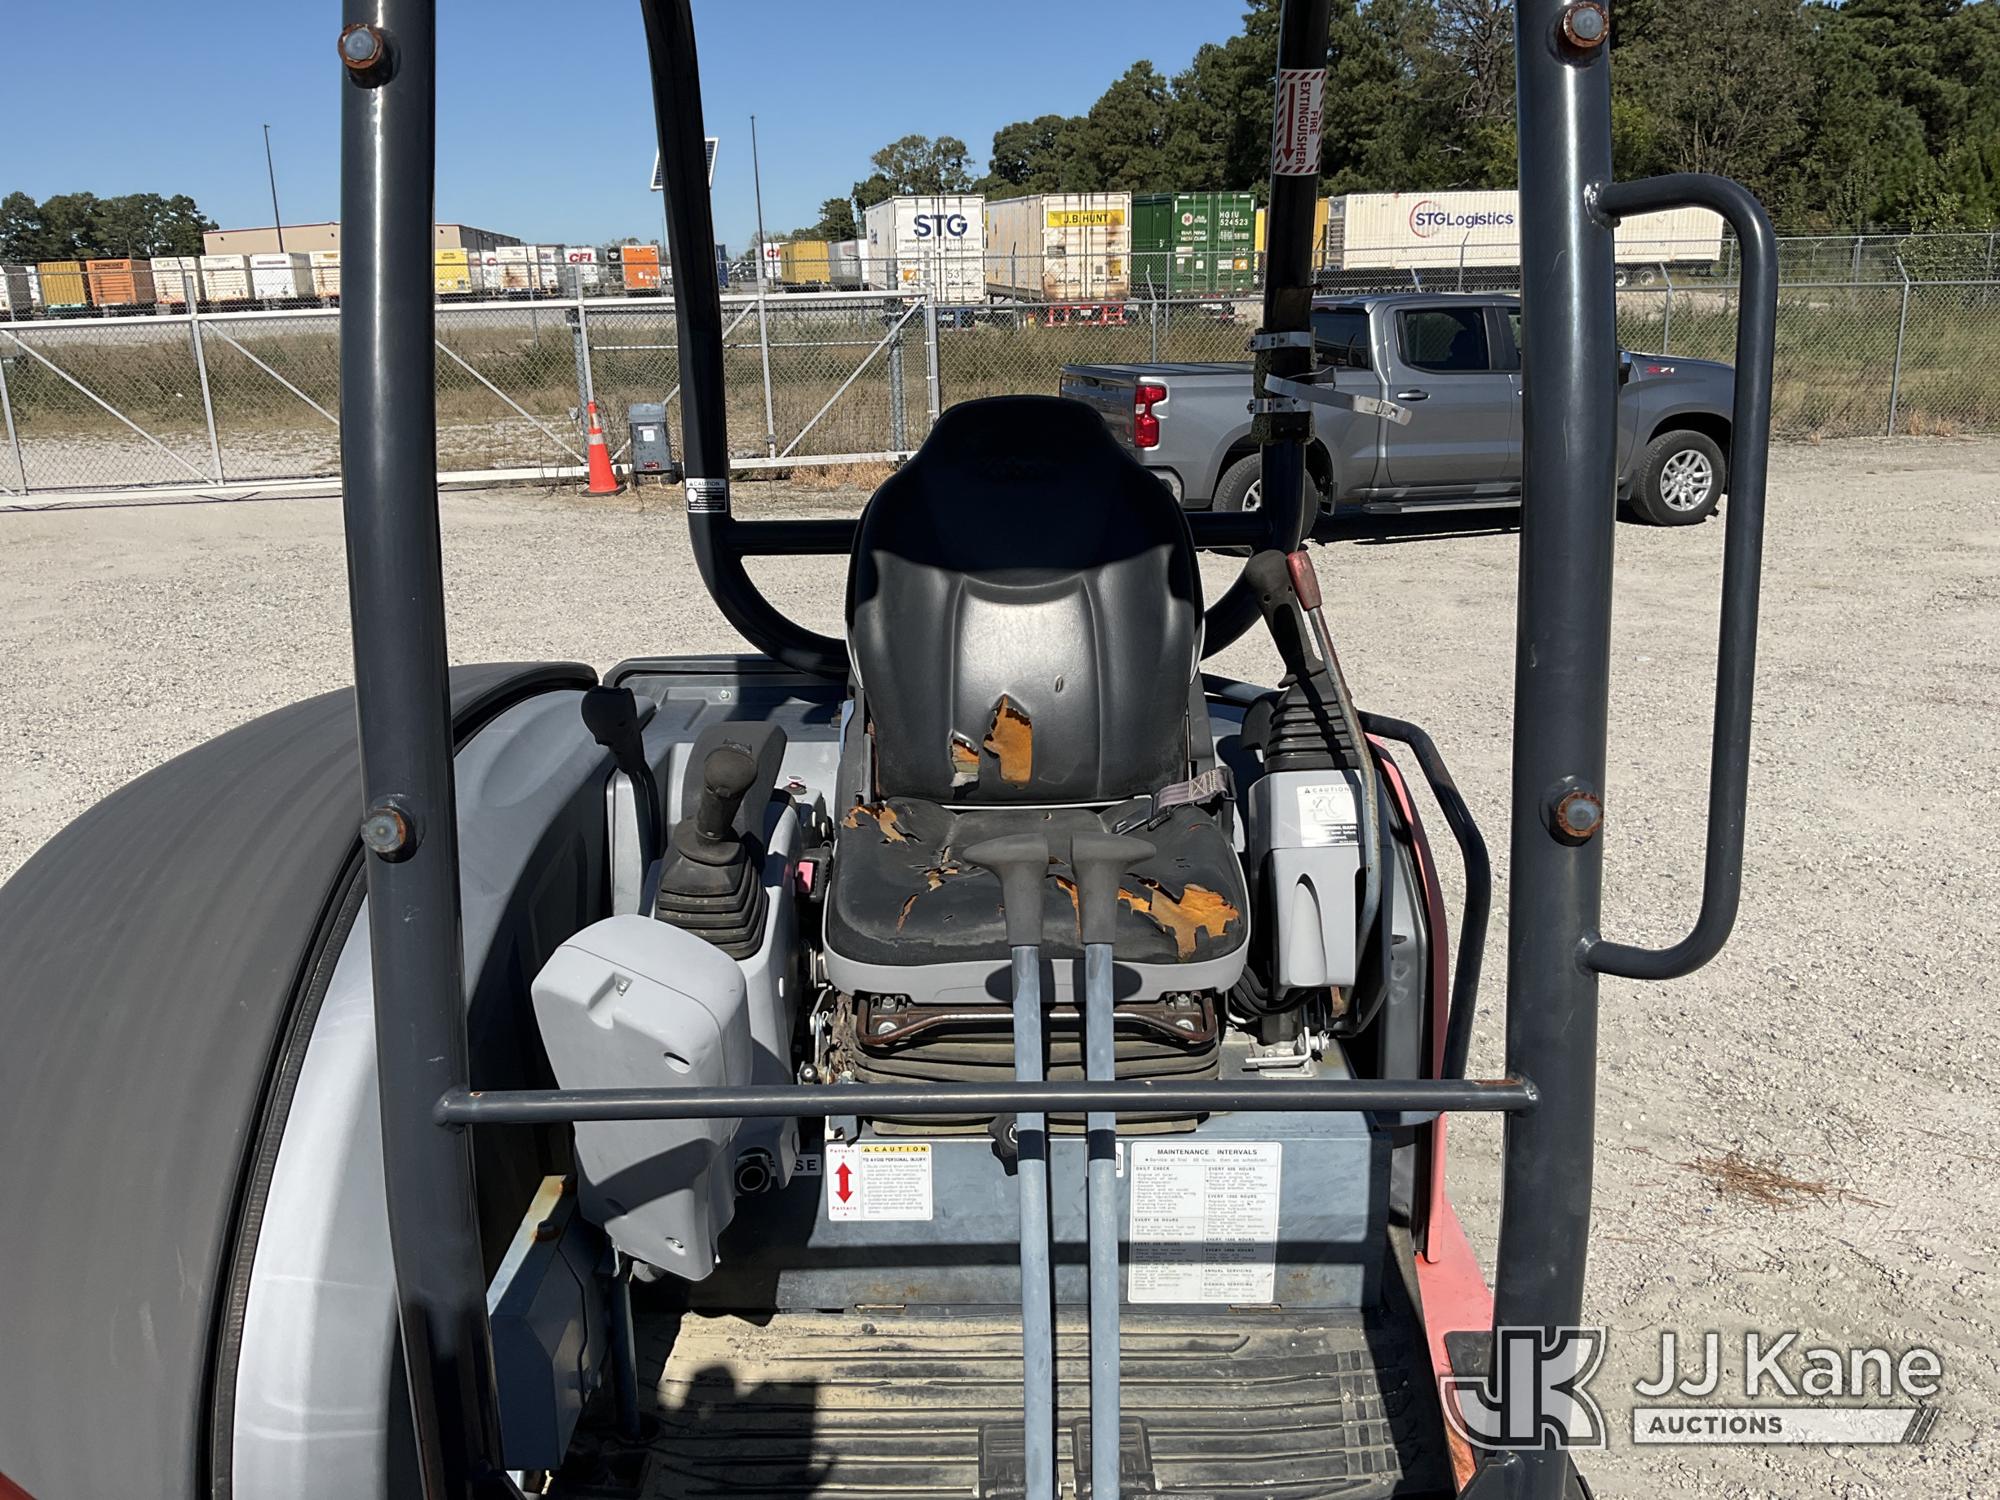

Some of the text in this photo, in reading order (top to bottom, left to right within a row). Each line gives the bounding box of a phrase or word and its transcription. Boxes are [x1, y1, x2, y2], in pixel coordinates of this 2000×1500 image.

[1295, 81, 1311, 165] EXTINGUISHER
[1309, 110, 1318, 135] FIRE
[913, 213, 968, 237] STG
[1083, 214, 1108, 223] HUNT
[569, 253, 592, 262] CFI
